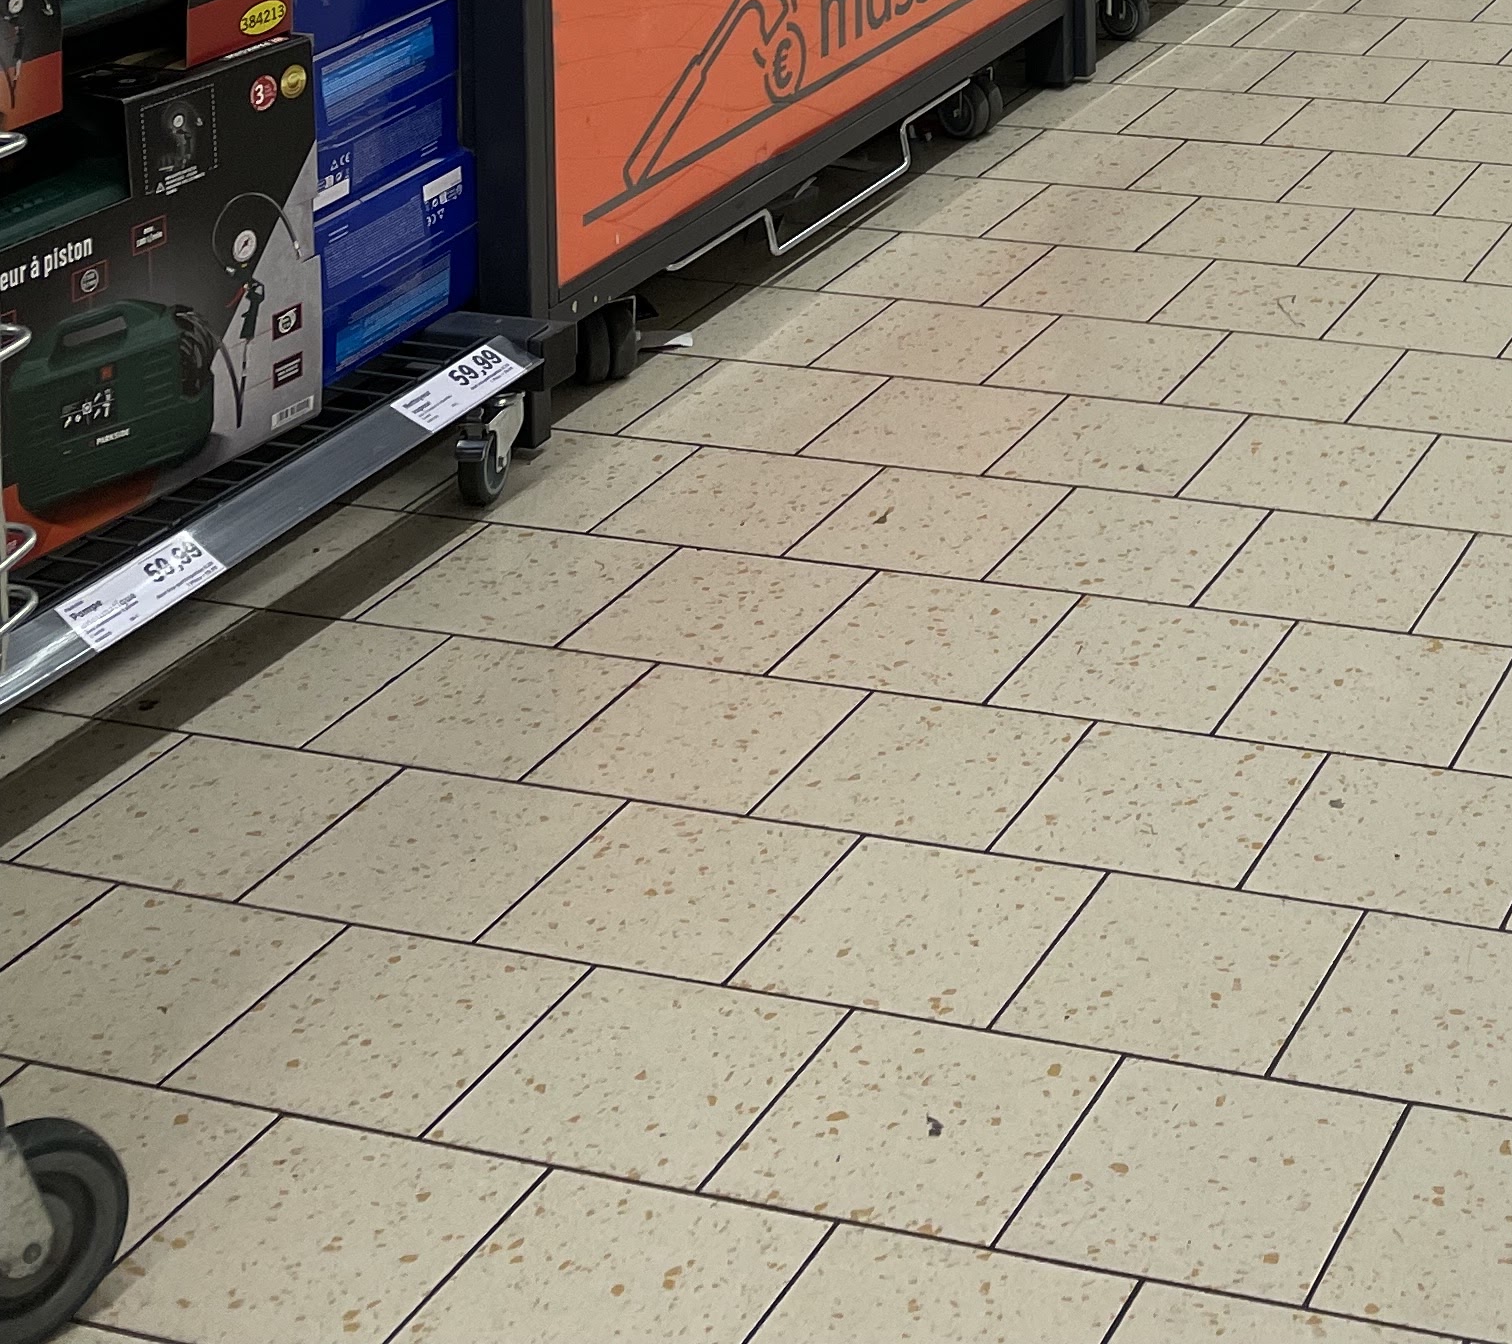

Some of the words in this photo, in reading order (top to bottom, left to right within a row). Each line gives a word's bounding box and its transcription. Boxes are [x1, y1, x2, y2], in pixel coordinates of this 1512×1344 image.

[241, 4, 285, 32] 384213
[254, 84, 265, 105] 3
[0, 264, 27, 292] eur
[30, 255, 40, 279] à
[43, 238, 94, 278] piston
[448, 349, 502, 386] 59,99
[144, 541, 203, 583] 59,99
